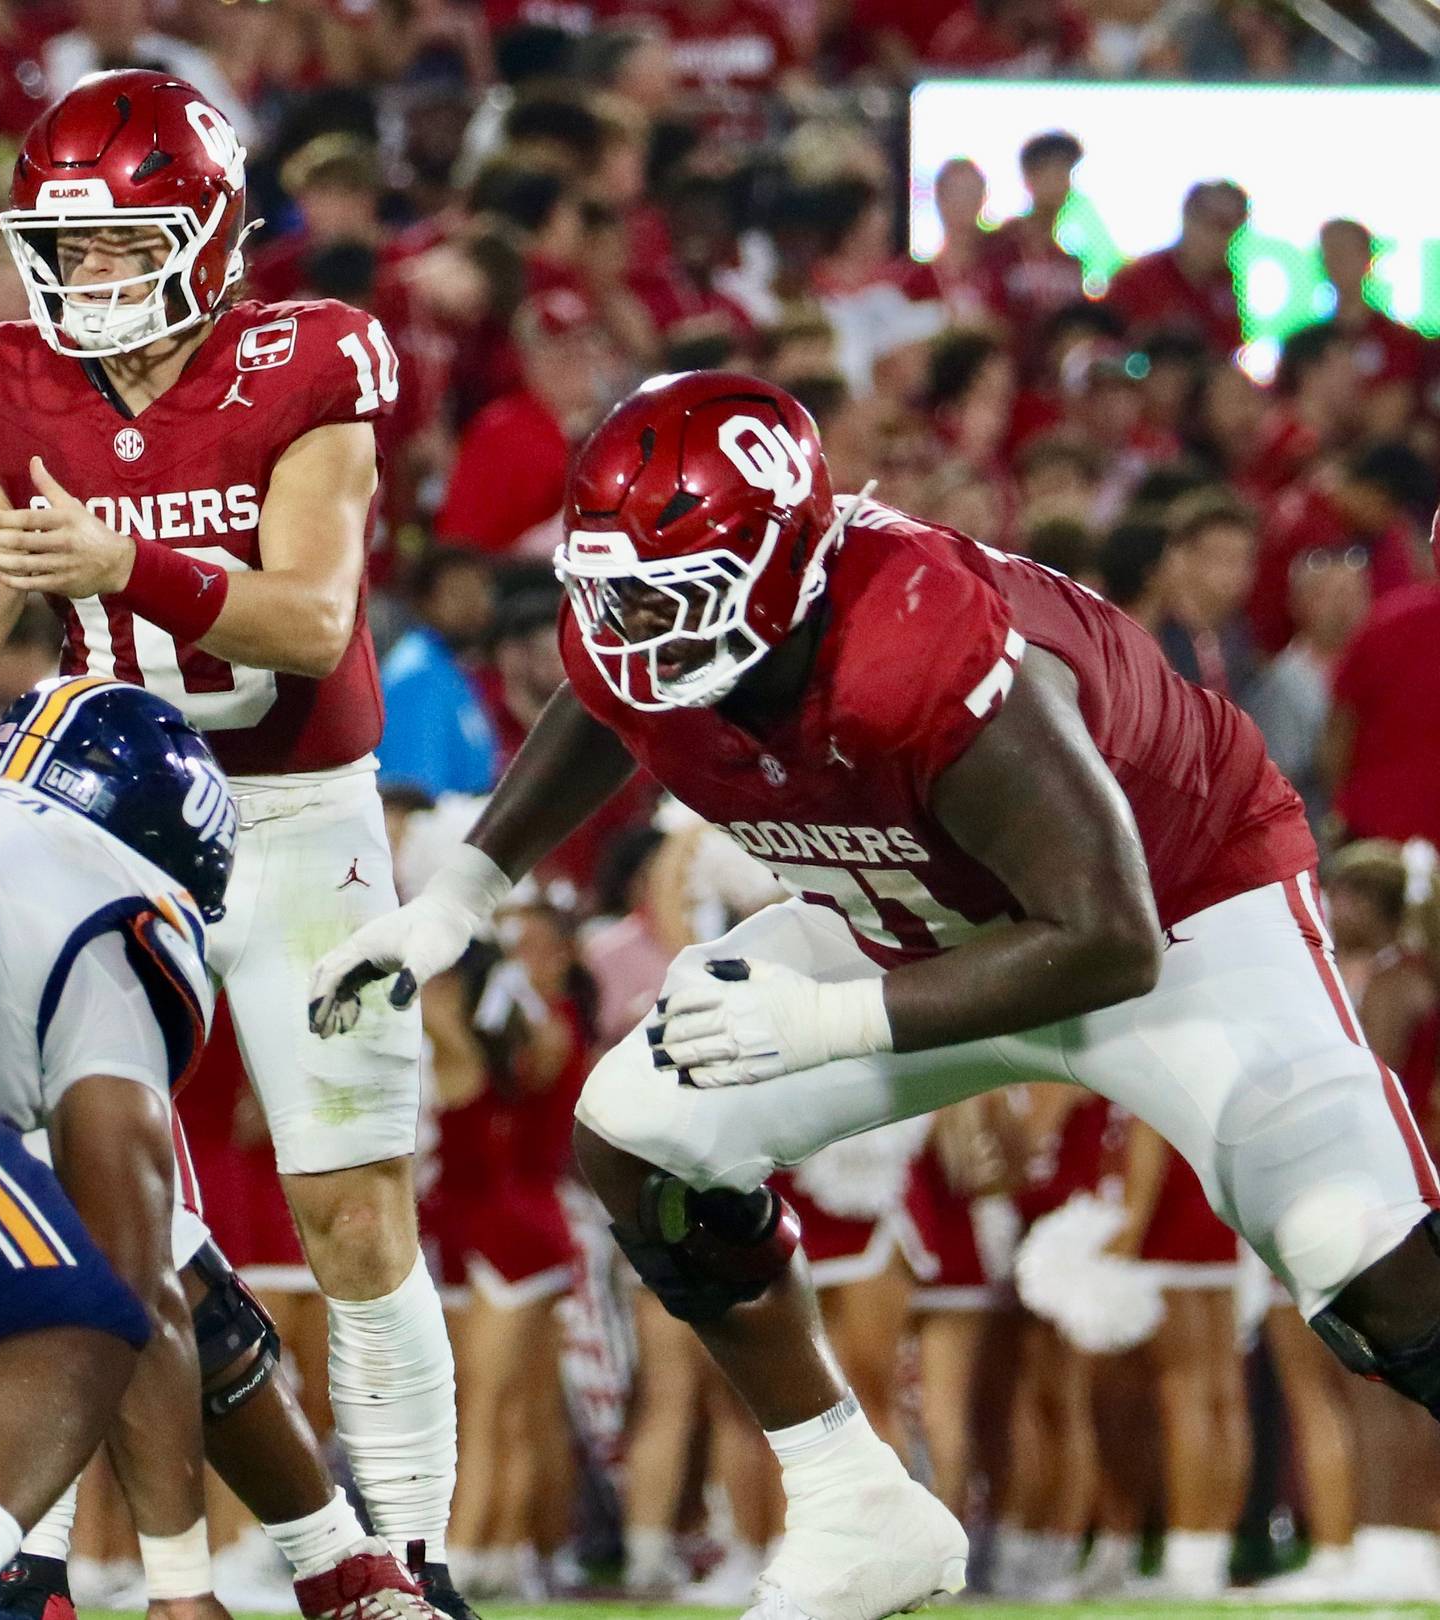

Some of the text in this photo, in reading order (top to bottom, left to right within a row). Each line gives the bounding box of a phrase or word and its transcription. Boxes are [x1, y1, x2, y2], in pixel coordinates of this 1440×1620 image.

[185, 100, 247, 190] OU
[242, 318, 294, 359] C
[336, 319, 400, 415] 10
[117, 429, 143, 459] SEC
[718, 415, 812, 508] OU
[28, 483, 260, 541] ONERS
[227, 1367, 265, 1404] DONJOY
